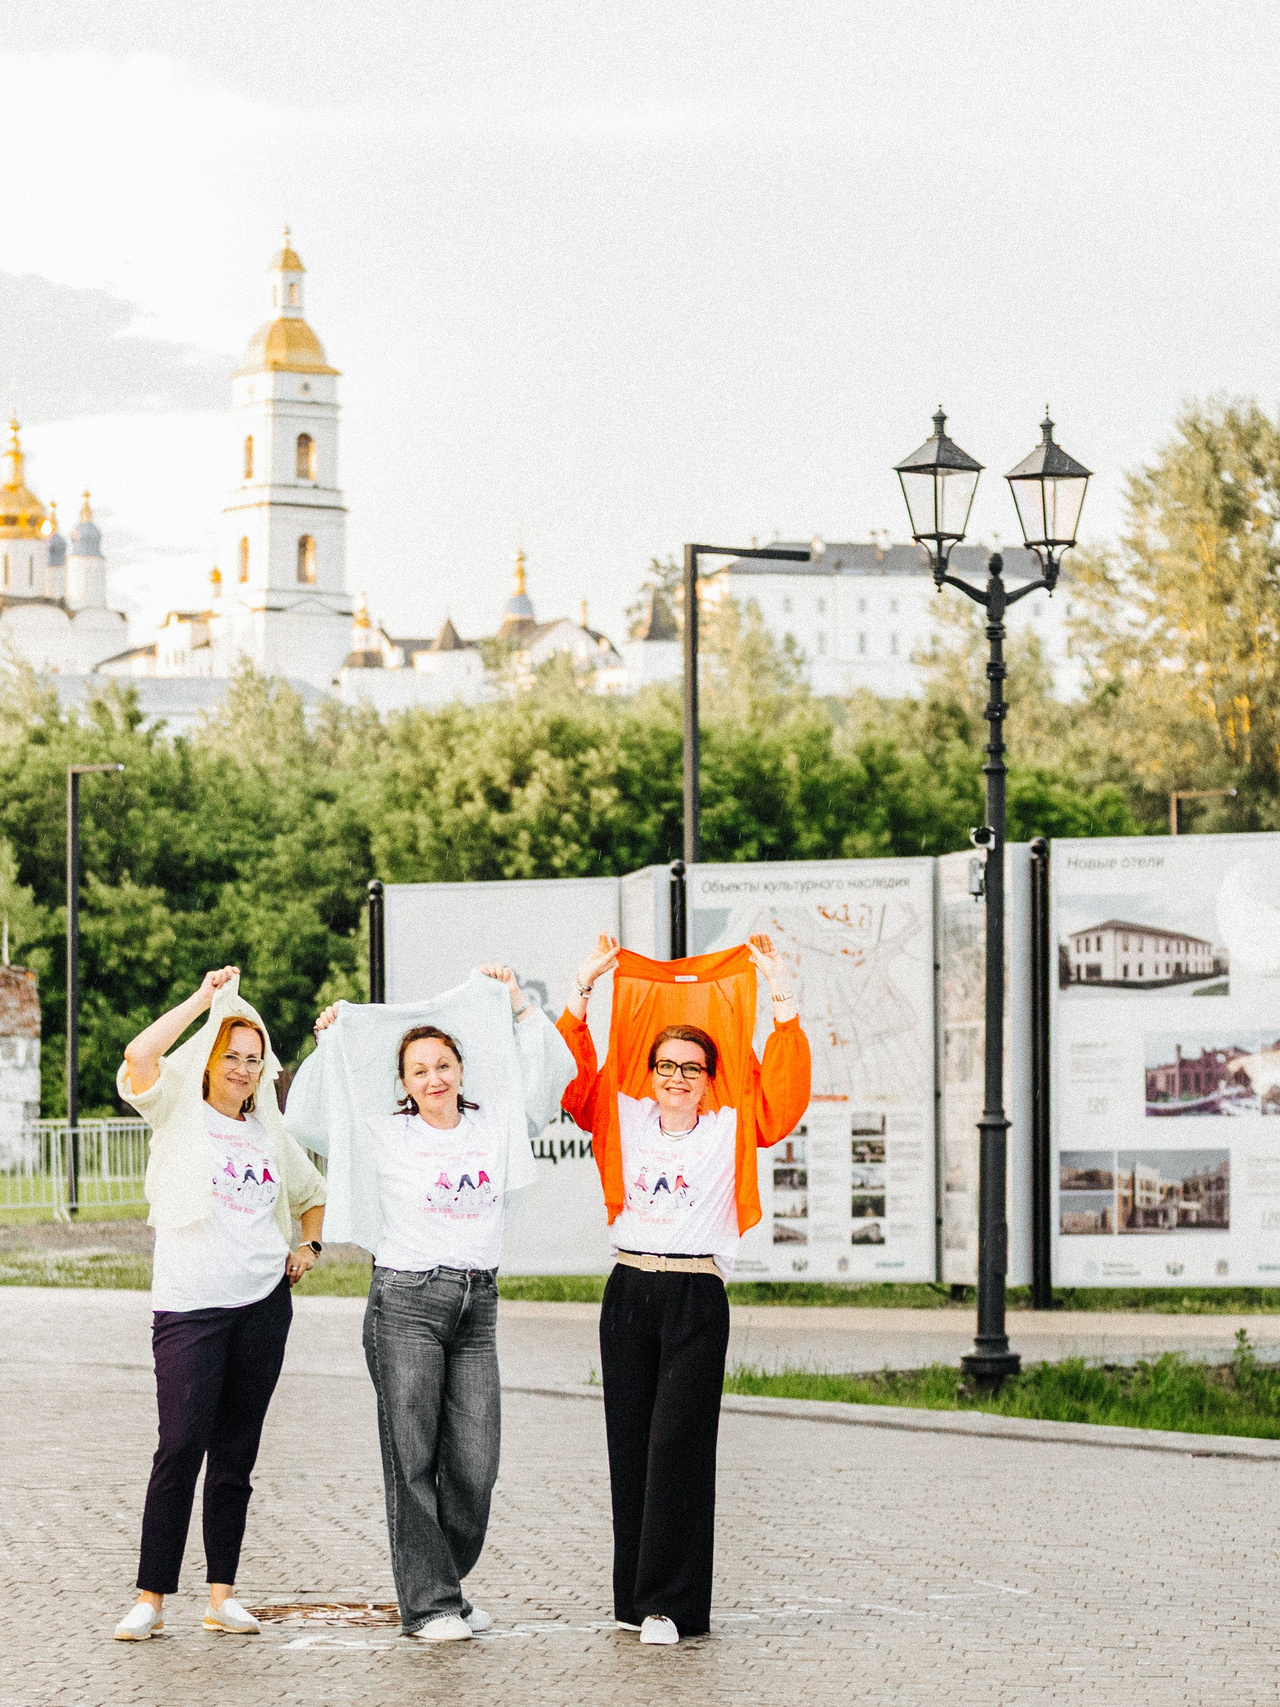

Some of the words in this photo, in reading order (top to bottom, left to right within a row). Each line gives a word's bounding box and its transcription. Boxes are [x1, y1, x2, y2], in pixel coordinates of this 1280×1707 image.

[1067, 857, 1118, 869] Новые
[1121, 856, 1165, 868] отели
[701, 880, 760, 894] Объекты
[763, 879, 844, 896] культурного
[847, 877, 910, 890] наследия
